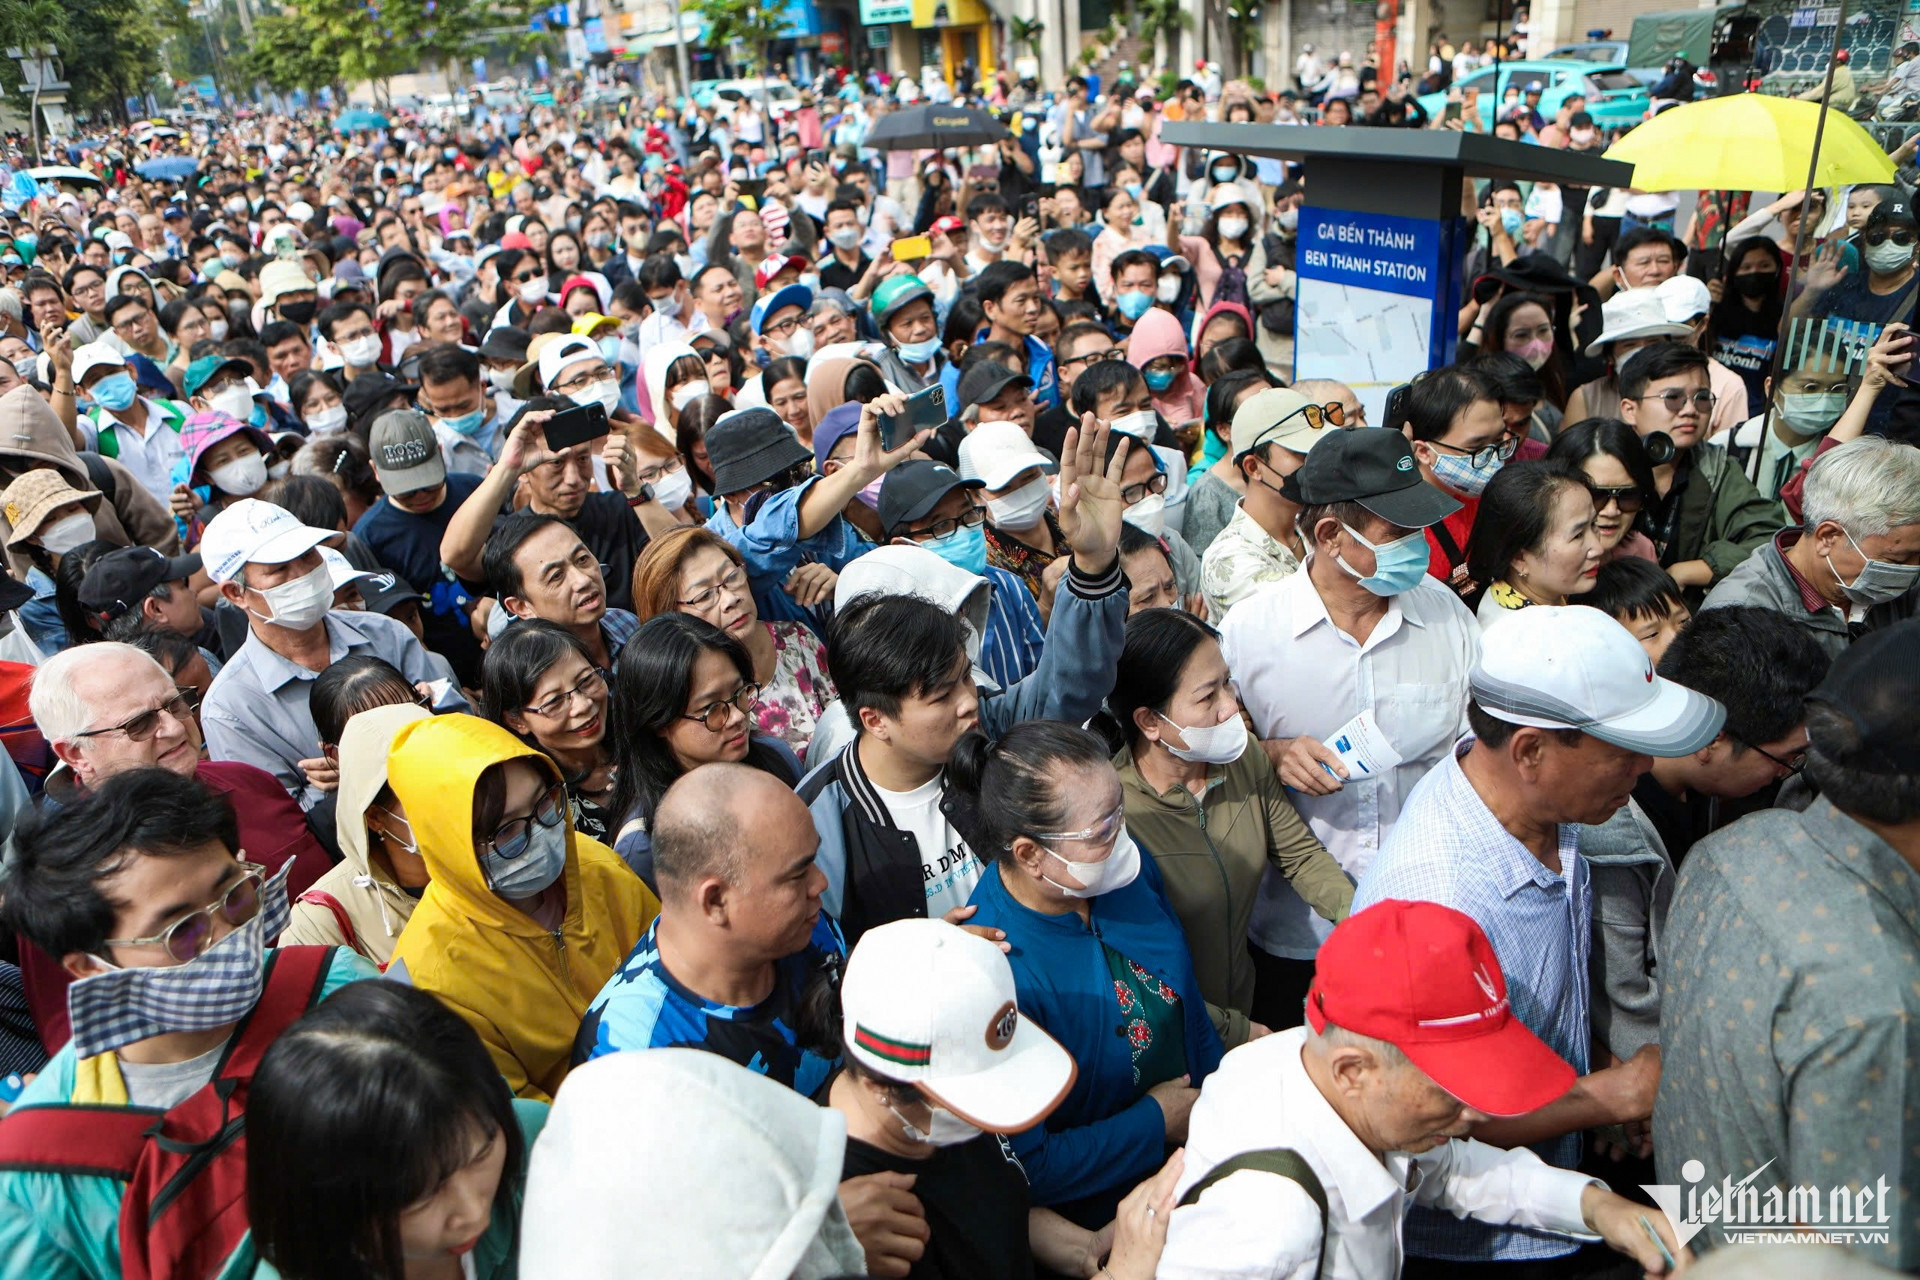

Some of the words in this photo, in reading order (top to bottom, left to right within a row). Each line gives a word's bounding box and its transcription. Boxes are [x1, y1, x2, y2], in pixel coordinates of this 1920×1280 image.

[1892, 203, 1903, 213] R
[1317, 223, 1335, 240] GA
[1338, 222, 1364, 244] BẾN
[1367, 227, 1415, 251] THÀNH
[1305, 249, 1328, 267] BEN
[1330, 253, 1371, 274] THANH
[1373, 259, 1426, 282] STATION
[383, 438, 425, 458] BOSS
